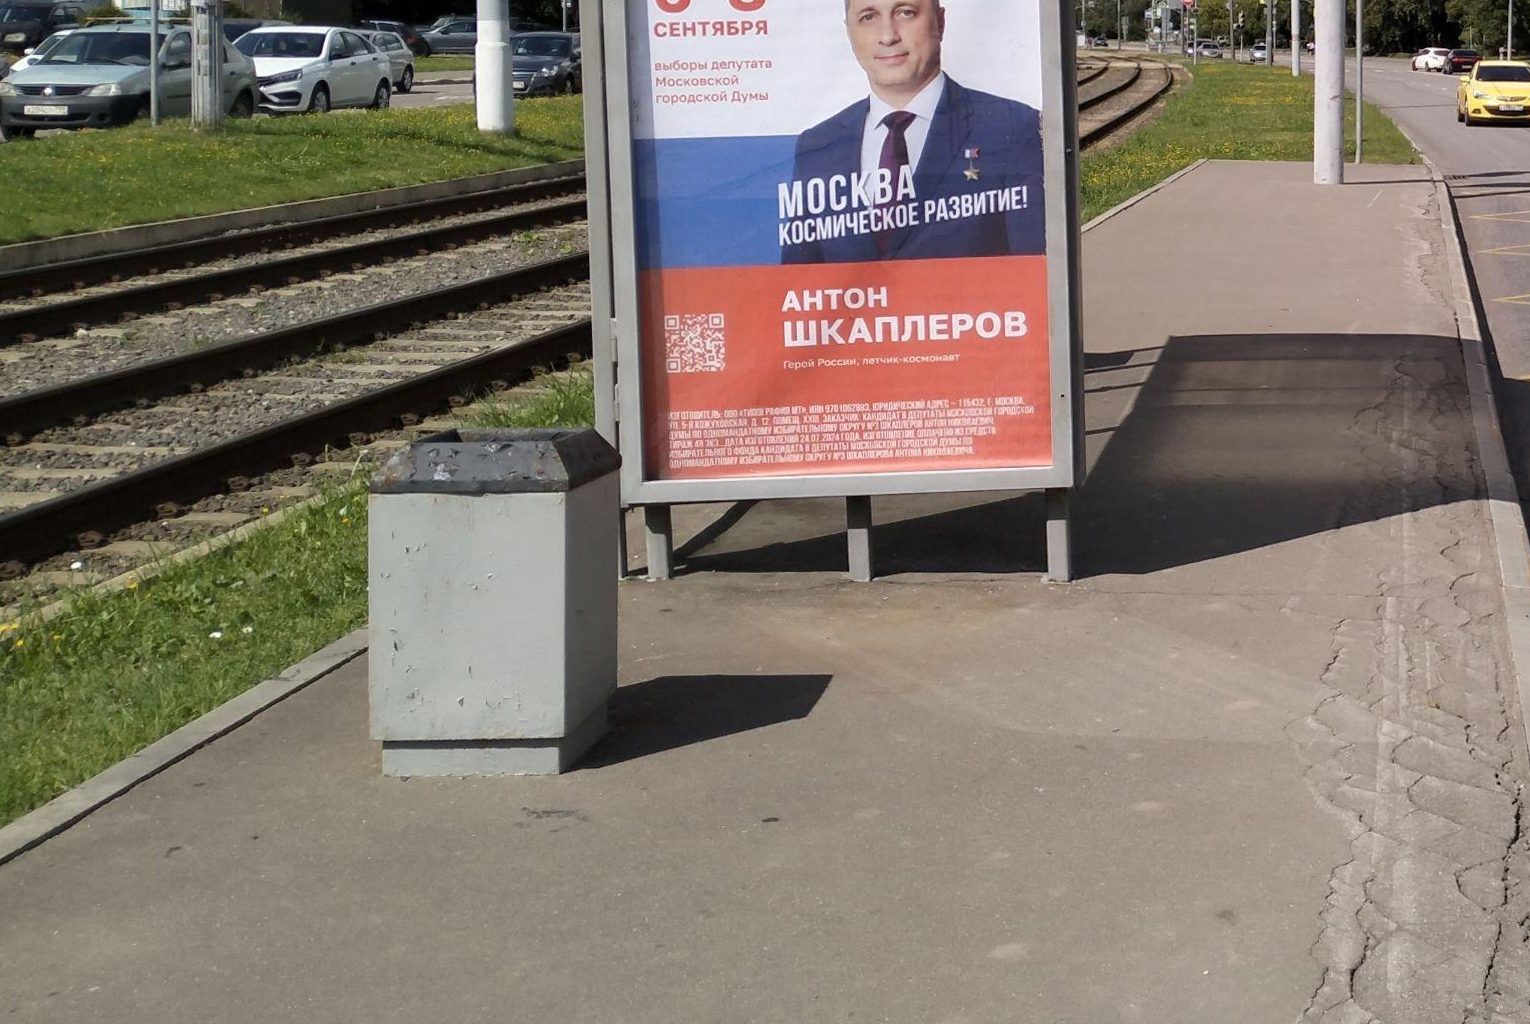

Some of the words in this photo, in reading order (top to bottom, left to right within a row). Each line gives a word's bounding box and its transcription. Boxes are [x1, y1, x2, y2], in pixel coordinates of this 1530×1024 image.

[654, 20, 768, 37] СЕНТЯБРЯ
[655, 60, 708, 73] выборы
[711, 59, 772, 72] депутата
[655, 75, 739, 87] Московской
[656, 91, 727, 105] городской
[731, 91, 769, 104] Думы
[778, 164, 916, 219] МОСКВА
[779, 202, 919, 246] КОСМИЧЕСКОЕ
[925, 185, 1028, 223] РАЗВИТИЕ!
[781, 286, 888, 312] АНТОН
[784, 311, 1028, 347] ШКАПЛЕРОВ
[783, 358, 815, 370] Герой
[818, 356, 860, 368] России,
[927, 400, 949, 408] АДРЕС
[863, 411, 900, 421] КАНДИДАТ
[908, 409, 945, 419] ДЕПУТАТЫ
[840, 423, 866, 432] ОКРУГУ
[924, 419, 946, 428] АНТОН
